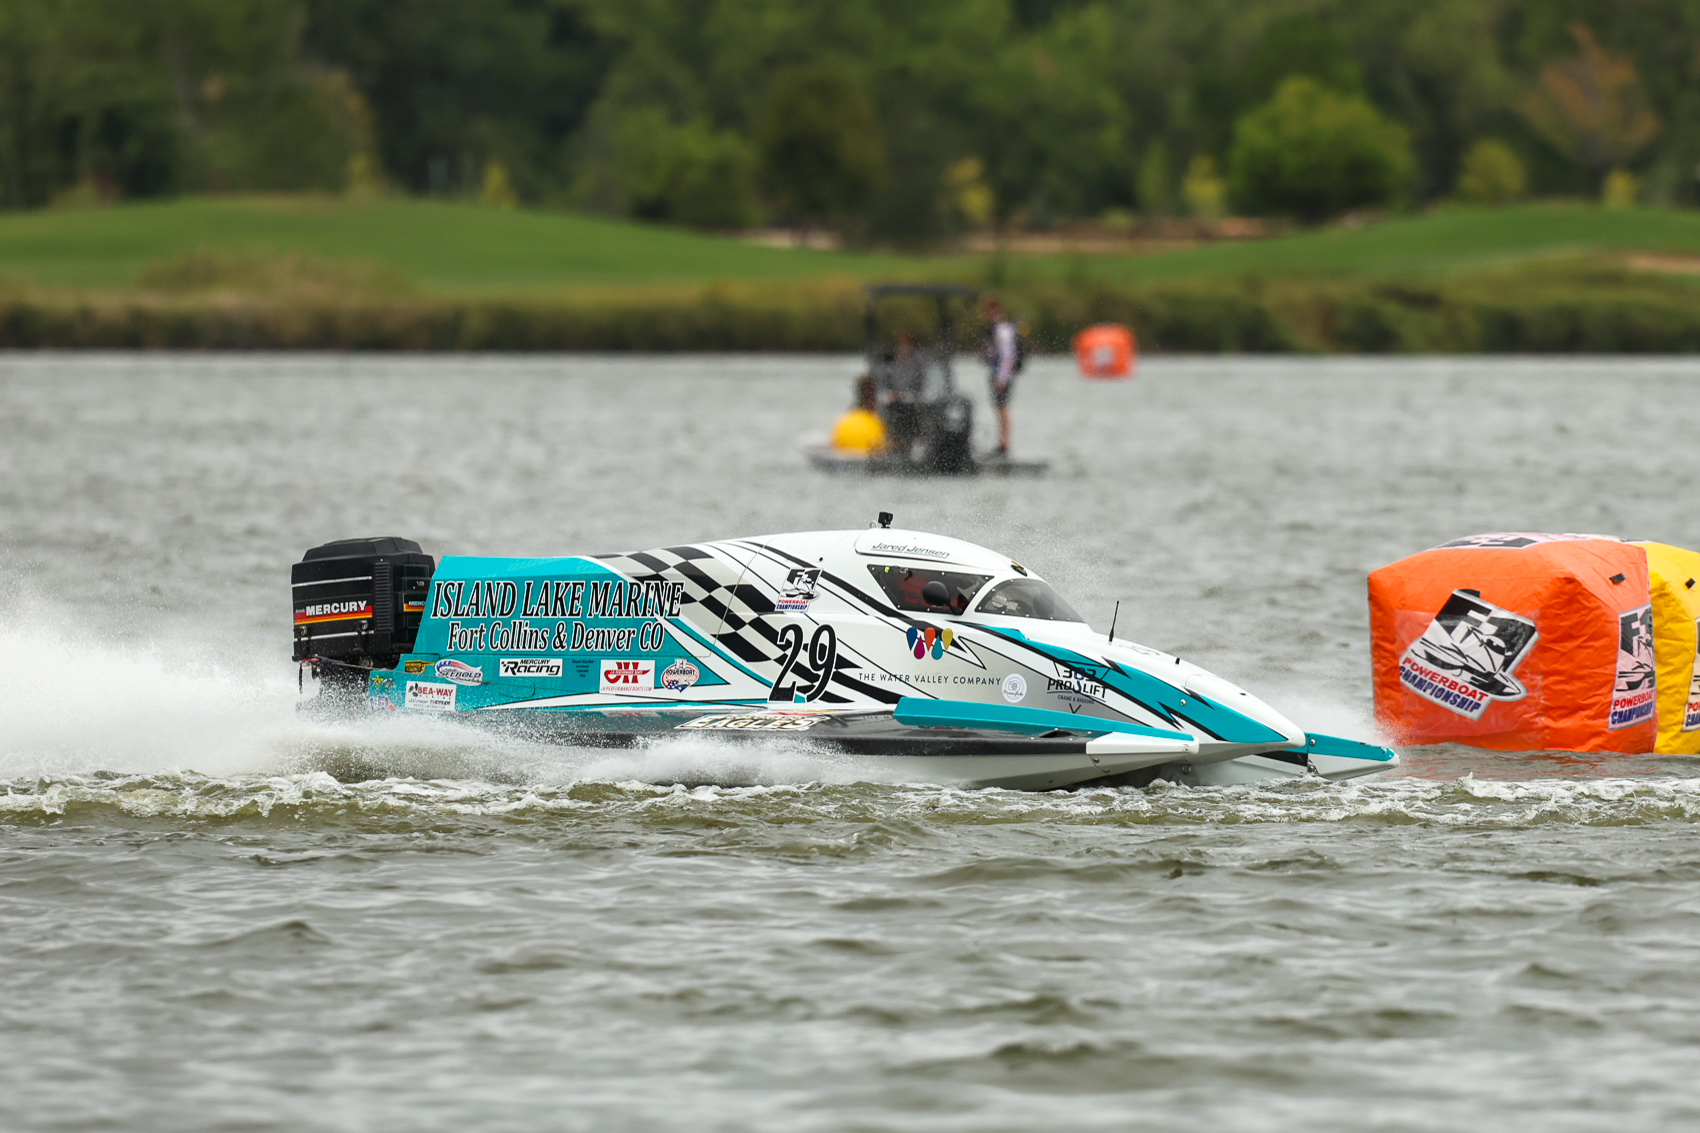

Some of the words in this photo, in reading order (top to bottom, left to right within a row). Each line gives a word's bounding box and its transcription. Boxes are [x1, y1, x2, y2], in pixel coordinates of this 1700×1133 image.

[872, 542, 907, 551] Jared
[907, 546, 950, 558] Jensen
[305, 600, 367, 617] MERCURY
[430, 580, 517, 618] ISLAND
[520, 580, 585, 618] LAKE
[587, 580, 685, 619] MARINE
[447, 620, 486, 651] Fort
[489, 619, 549, 651] Collins
[551, 621, 567, 651] &
[570, 622, 637, 651] Denver
[639, 621, 665, 651] CO
[503, 661, 561, 676] Racing
[666, 668, 695, 676] POWERBOAT
[769, 623, 837, 703] 29
[859, 672, 876, 681] THE
[879, 673, 910, 682] WATER
[914, 674, 949, 684] VALLEY
[952, 675, 1001, 685] COMPANY
[1402, 656, 1489, 702] POWERBOAT
[418, 686, 454, 697] SEA-WAY
[1047, 678, 1072, 691] PRO
[1082, 683, 1109, 699] LIFT
[1399, 665, 1482, 713] CHAMPIONSHIP
[1613, 689, 1654, 710] POWERBOAT
[683, 714, 822, 730] EAGLES
